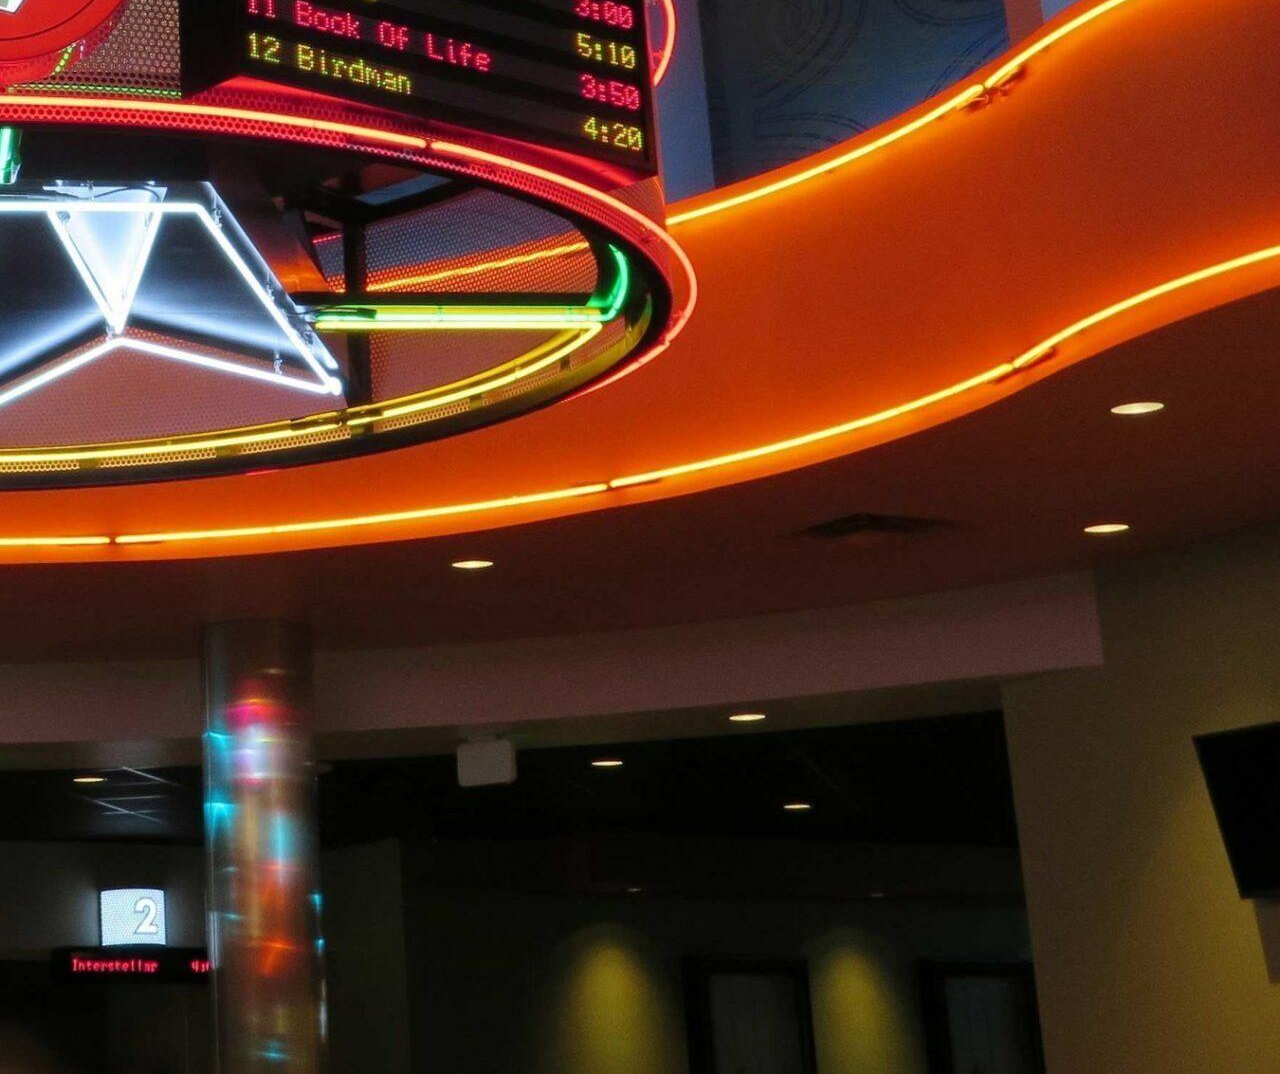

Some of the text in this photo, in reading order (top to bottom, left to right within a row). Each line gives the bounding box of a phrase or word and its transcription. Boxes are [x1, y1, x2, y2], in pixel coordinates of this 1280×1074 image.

[295, 0, 360, 38] Book
[377, 22, 408, 50] Of
[426, 34, 490, 71] Life
[580, 74, 640, 110] 3:50
[577, 33, 635, 68] 5:10
[249, 33, 642, 151] 12 Birdman 4:20
[134, 897, 158, 934] 2
[71, 957, 158, 973] Interstellar
